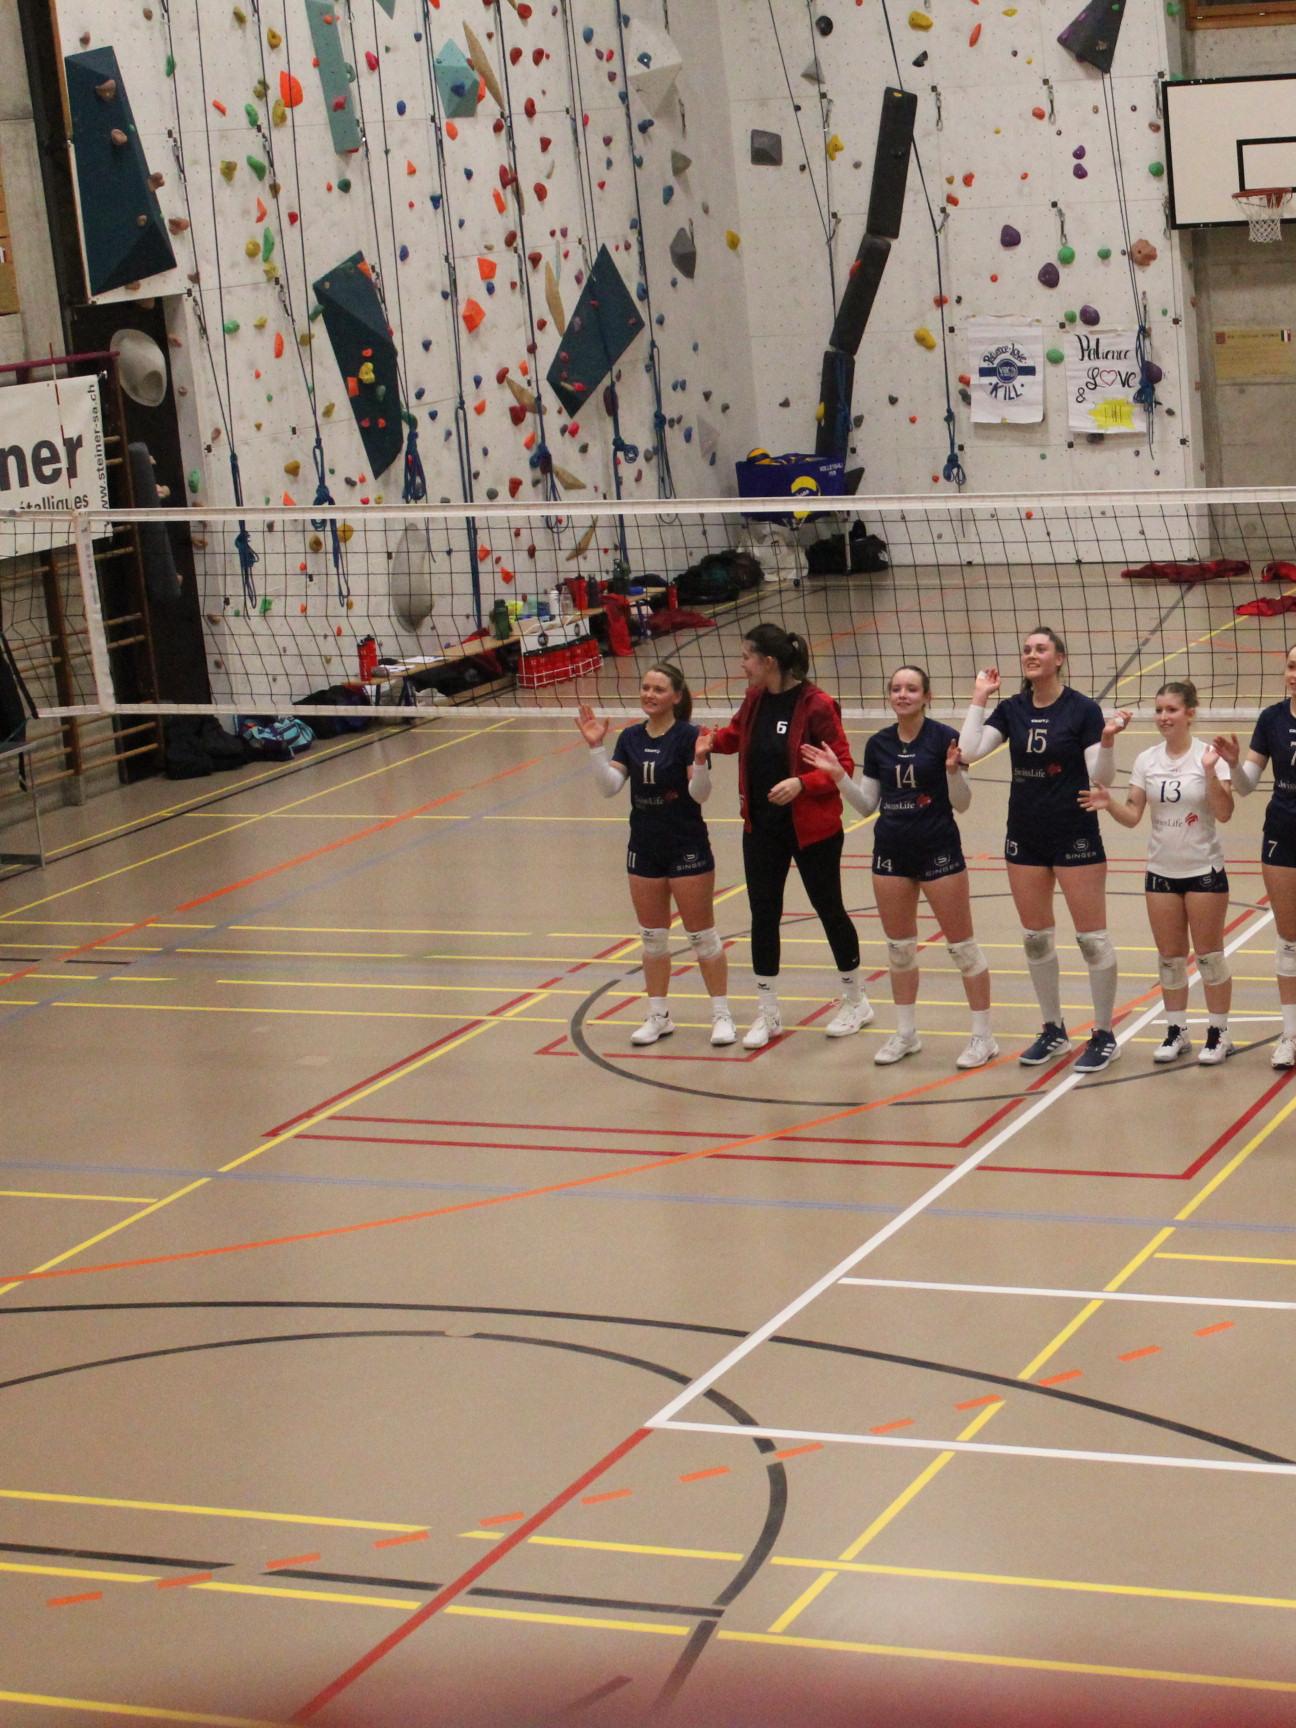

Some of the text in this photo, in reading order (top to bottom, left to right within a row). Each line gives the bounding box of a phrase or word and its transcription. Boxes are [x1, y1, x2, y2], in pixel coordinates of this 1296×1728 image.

[1075, 334, 1131, 361] Patience
[1075, 387, 1086, 403] &
[87, 384, 110, 510] ww.steiner-sa.ch
[0, 434, 83, 492] ner
[776, 721, 788, 734] 6
[1026, 728, 1047, 753] 15
[642, 761, 656, 784] 11
[895, 763, 916, 788] 14
[1160, 780, 1181, 803] 13
[628, 851, 637, 868] 11
[1268, 840, 1278, 858] 7
[876, 855, 892, 872] 14
